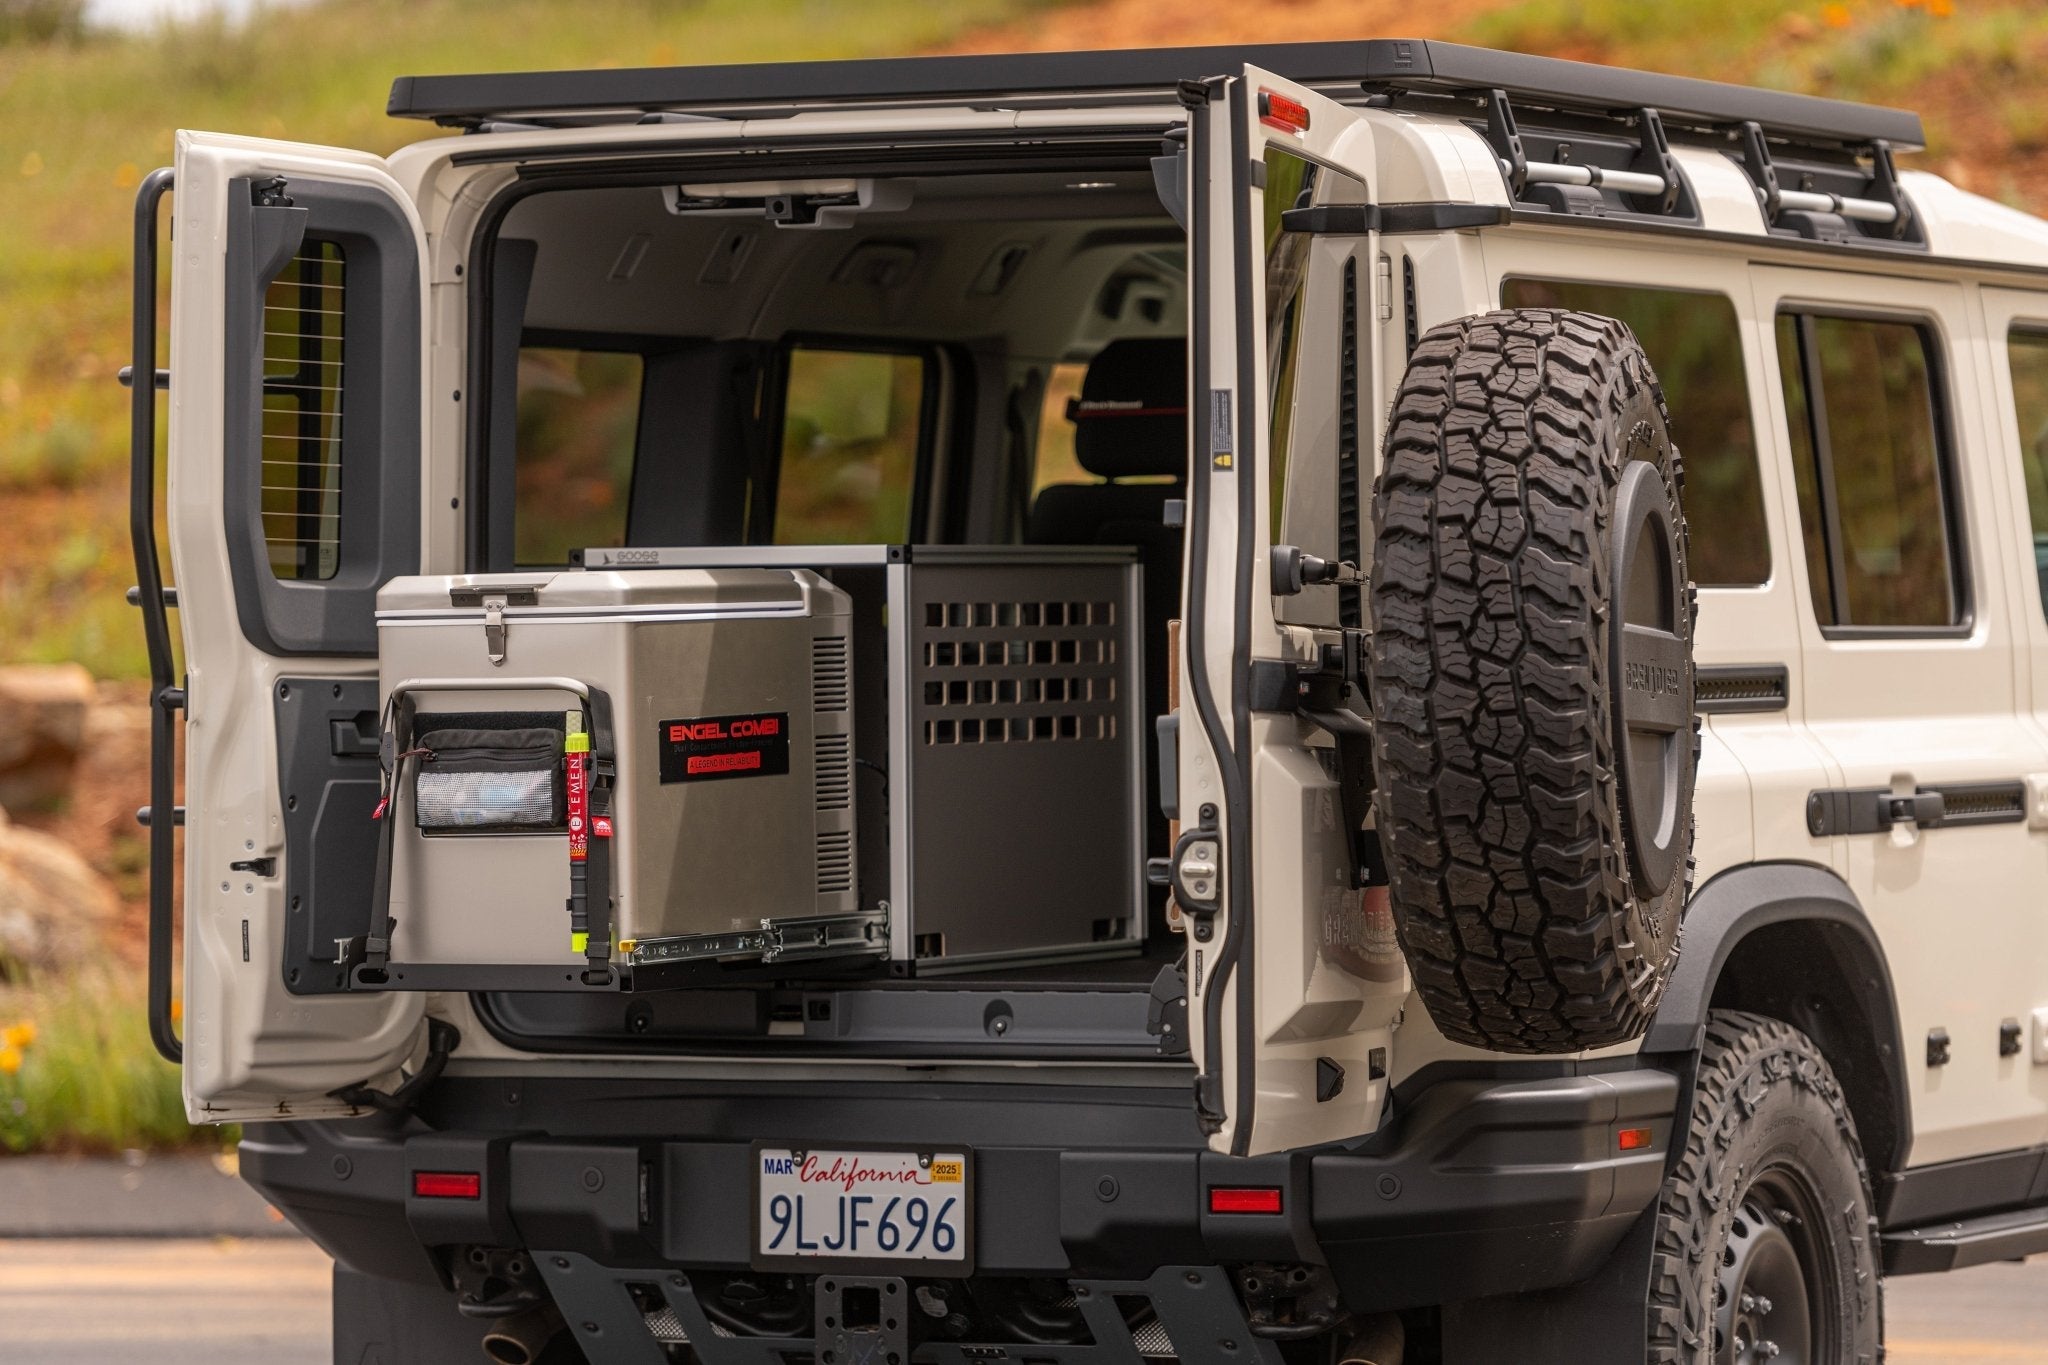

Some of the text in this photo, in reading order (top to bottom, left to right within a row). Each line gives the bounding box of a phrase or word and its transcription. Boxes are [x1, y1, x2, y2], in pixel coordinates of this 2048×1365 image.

[669, 718, 779, 742] ENGEL COMBI
[695, 758, 718, 769] LEGEND
[570, 752, 582, 831] ELEMEN
[764, 1158, 793, 1175] MAR
[800, 1155, 932, 1192] California
[936, 1164, 957, 1174] 2025
[768, 1194, 957, 1253] 9LJF696
